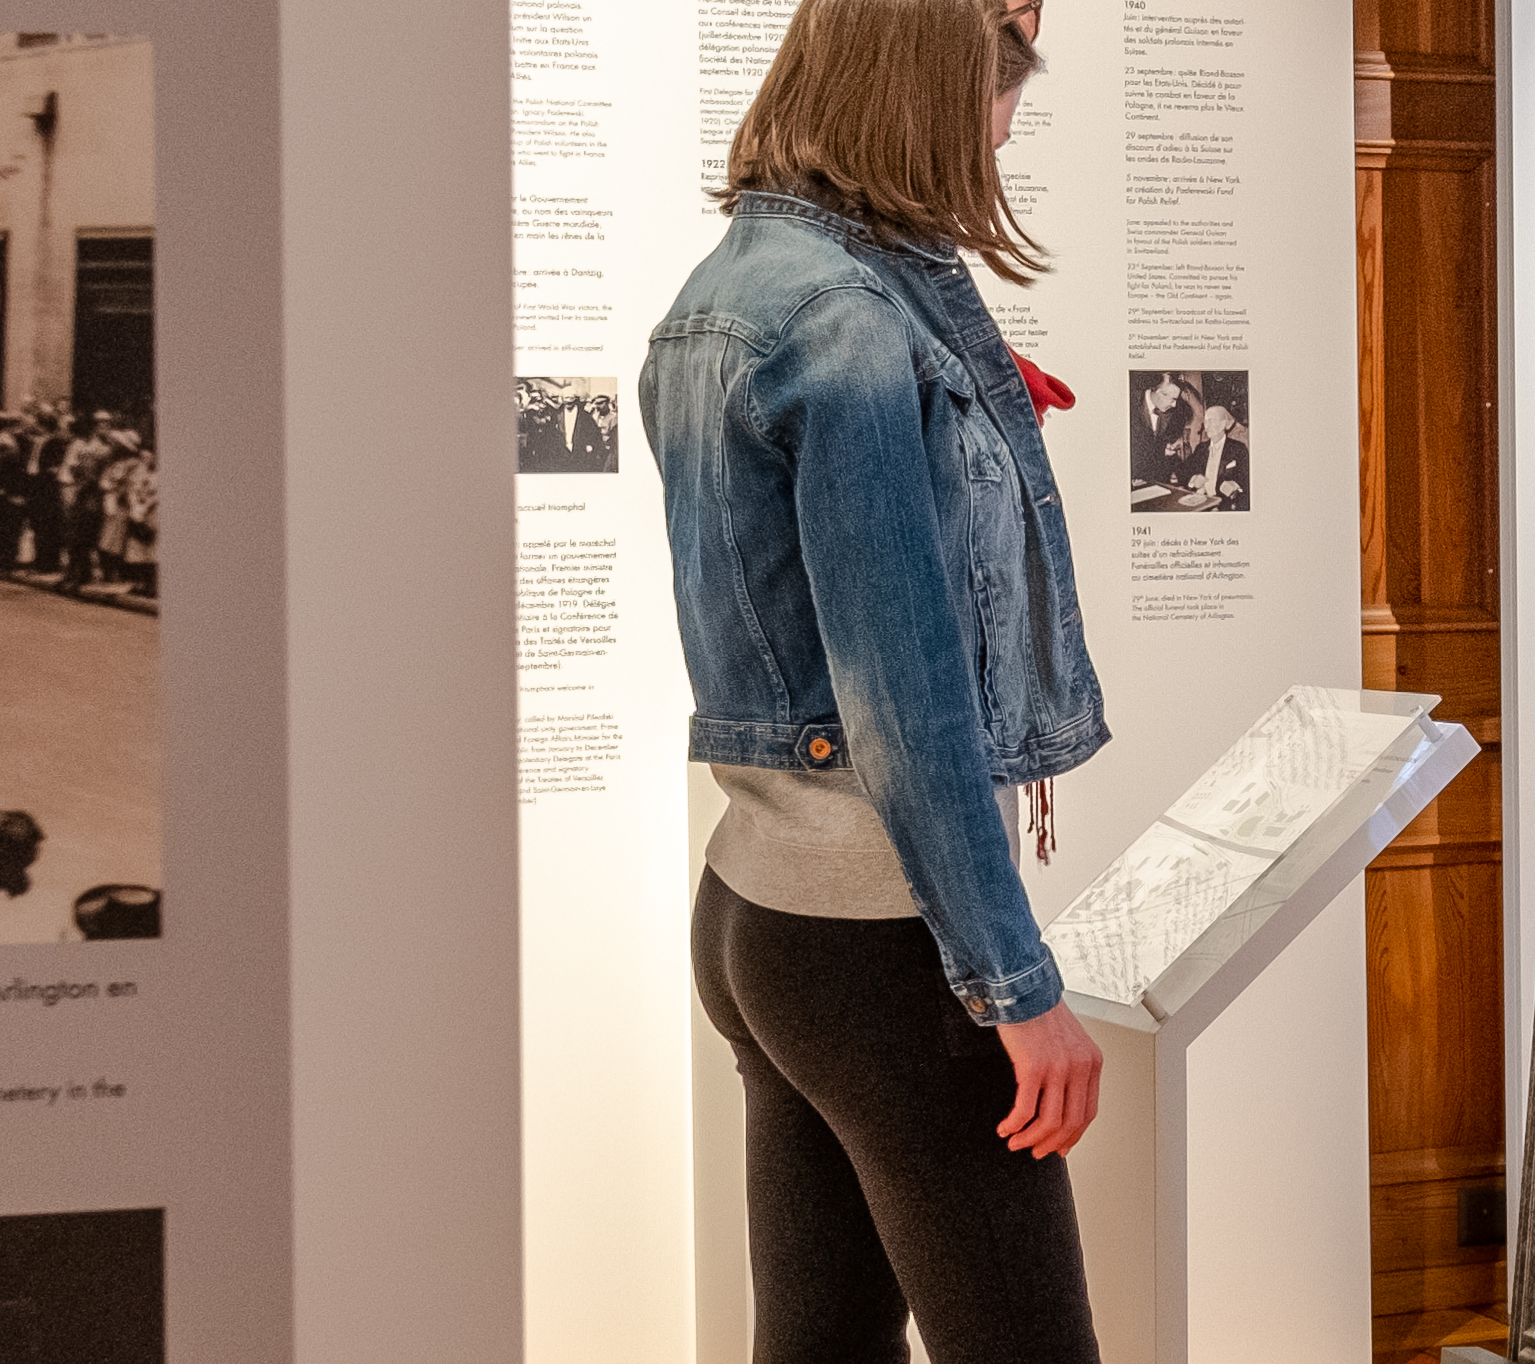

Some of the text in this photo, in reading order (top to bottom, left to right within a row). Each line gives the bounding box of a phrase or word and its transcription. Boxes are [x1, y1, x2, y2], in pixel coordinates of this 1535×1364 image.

[1125, 1, 1146, 10] 1940
[702, 159, 726, 169] 1922
[1132, 527, 1151, 535] 1941
[106, 981, 138, 998] en
